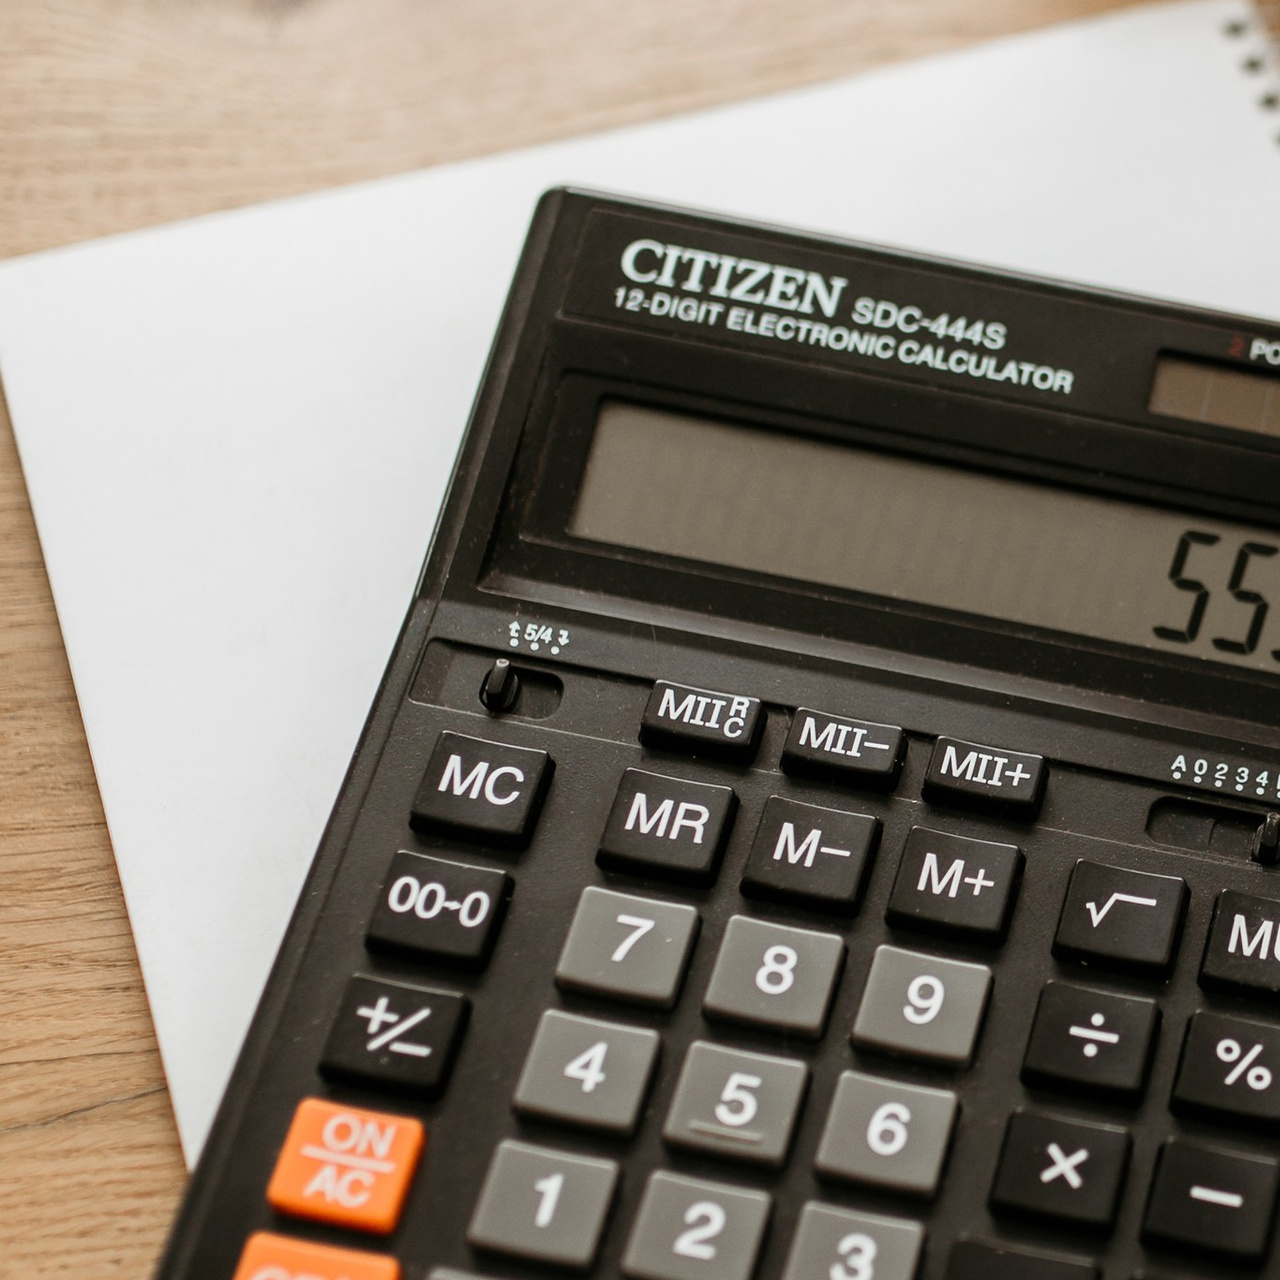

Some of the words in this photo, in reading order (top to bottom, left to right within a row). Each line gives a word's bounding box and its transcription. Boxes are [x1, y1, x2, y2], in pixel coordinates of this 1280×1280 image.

[620, 238, 848, 318] CITIZEN
[851, 297, 1008, 351] SDC-444S
[614, 286, 726, 327] 12-DIGIT
[727, 307, 896, 360] ELECTRONIC
[897, 340, 1075, 394] CALCULATOR
[524, 623, 553, 644] 5/4
[437, 754, 525, 805] MC
[1171, 755, 1187, 772] A
[1215, 763, 1229, 780] 2
[1235, 767, 1250, 783] 3
[1255, 771, 1269, 787] 4
[624, 792, 710, 844] MR
[916, 852, 995, 898] M+
[610, 914, 656, 962] 7
[755, 945, 798, 995] 8
[903, 975, 945, 1024] 9
[563, 1041, 609, 1093] 4
[1215, 1037, 1273, 1091] %
[714, 1072, 762, 1126] 5
[321, 1114, 396, 1158] ON
[866, 1101, 911, 1156] 6
[302, 1164, 375, 1208] AC
[534, 1173, 565, 1228] 1
[672, 1201, 727, 1261] 2
